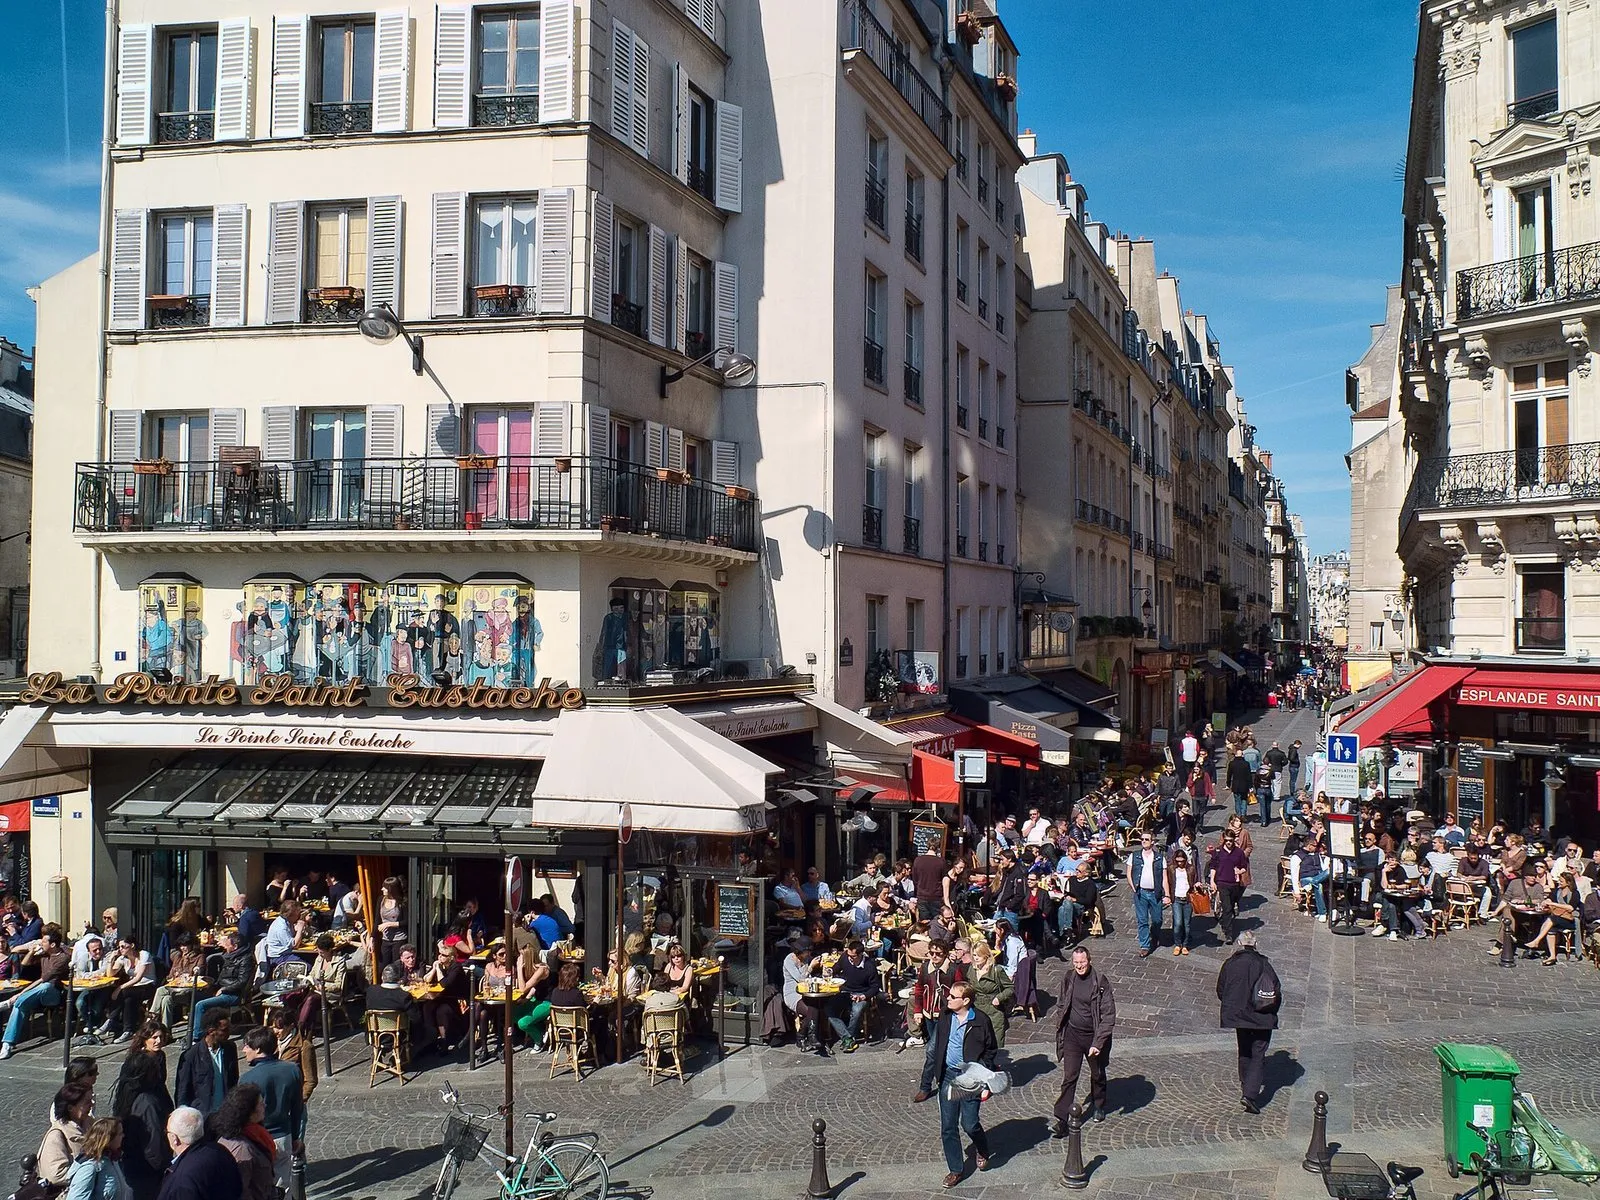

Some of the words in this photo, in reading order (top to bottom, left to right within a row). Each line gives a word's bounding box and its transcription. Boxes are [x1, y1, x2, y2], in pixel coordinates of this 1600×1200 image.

[19, 671, 95, 704] La
[104, 671, 237, 705] Pointe
[249, 673, 365, 708] Saint
[386, 673, 584, 709] Eustache
[735, 721, 757, 737] Saint
[758, 716, 790, 735] Eustache
[1011, 722, 1037, 731] Pizza
[1011, 729, 1037, 739] Pasta
[194, 726, 222, 744] La
[224, 727, 283, 744] Pointe
[284, 727, 337, 745] Saint
[338, 729, 416, 749] Eustache
